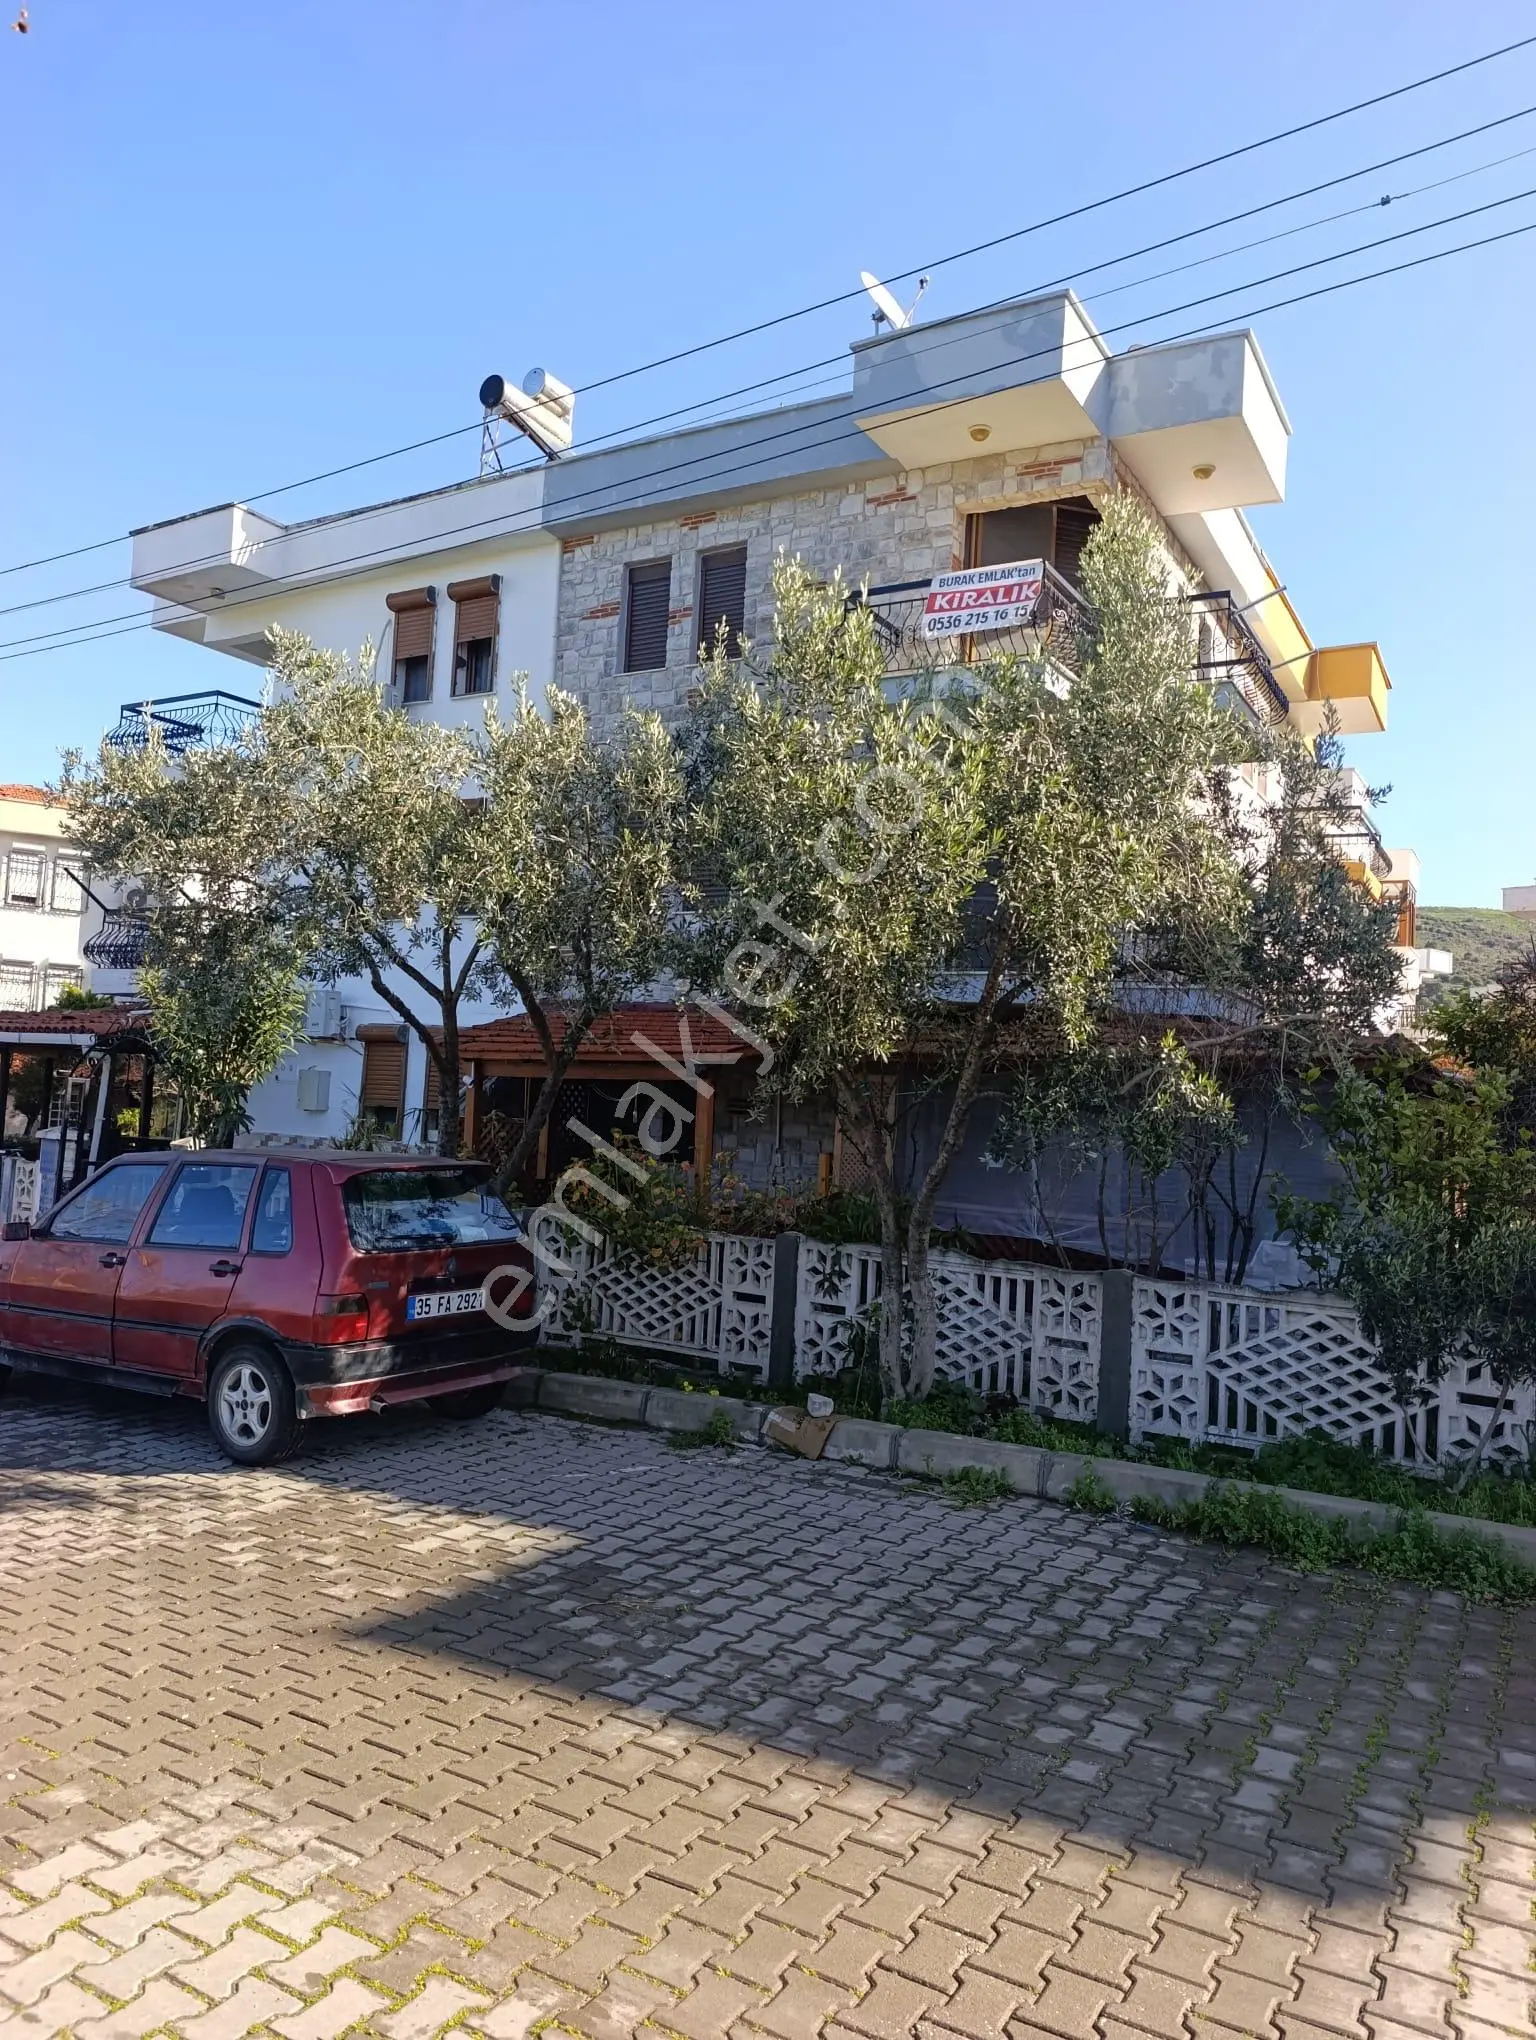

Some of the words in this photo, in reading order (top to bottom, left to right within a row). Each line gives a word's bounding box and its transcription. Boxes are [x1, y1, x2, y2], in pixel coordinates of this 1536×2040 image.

[939, 574, 976, 588] BURAK
[979, 567, 1036, 584] EMLAK'tan
[927, 614, 962, 632] 0536
[964, 611, 989, 627] 215
[993, 608, 1009, 621] 16
[1014, 604, 1030, 618] 15
[416, 1297, 431, 1316] 35
[437, 1295, 451, 1314] FA
